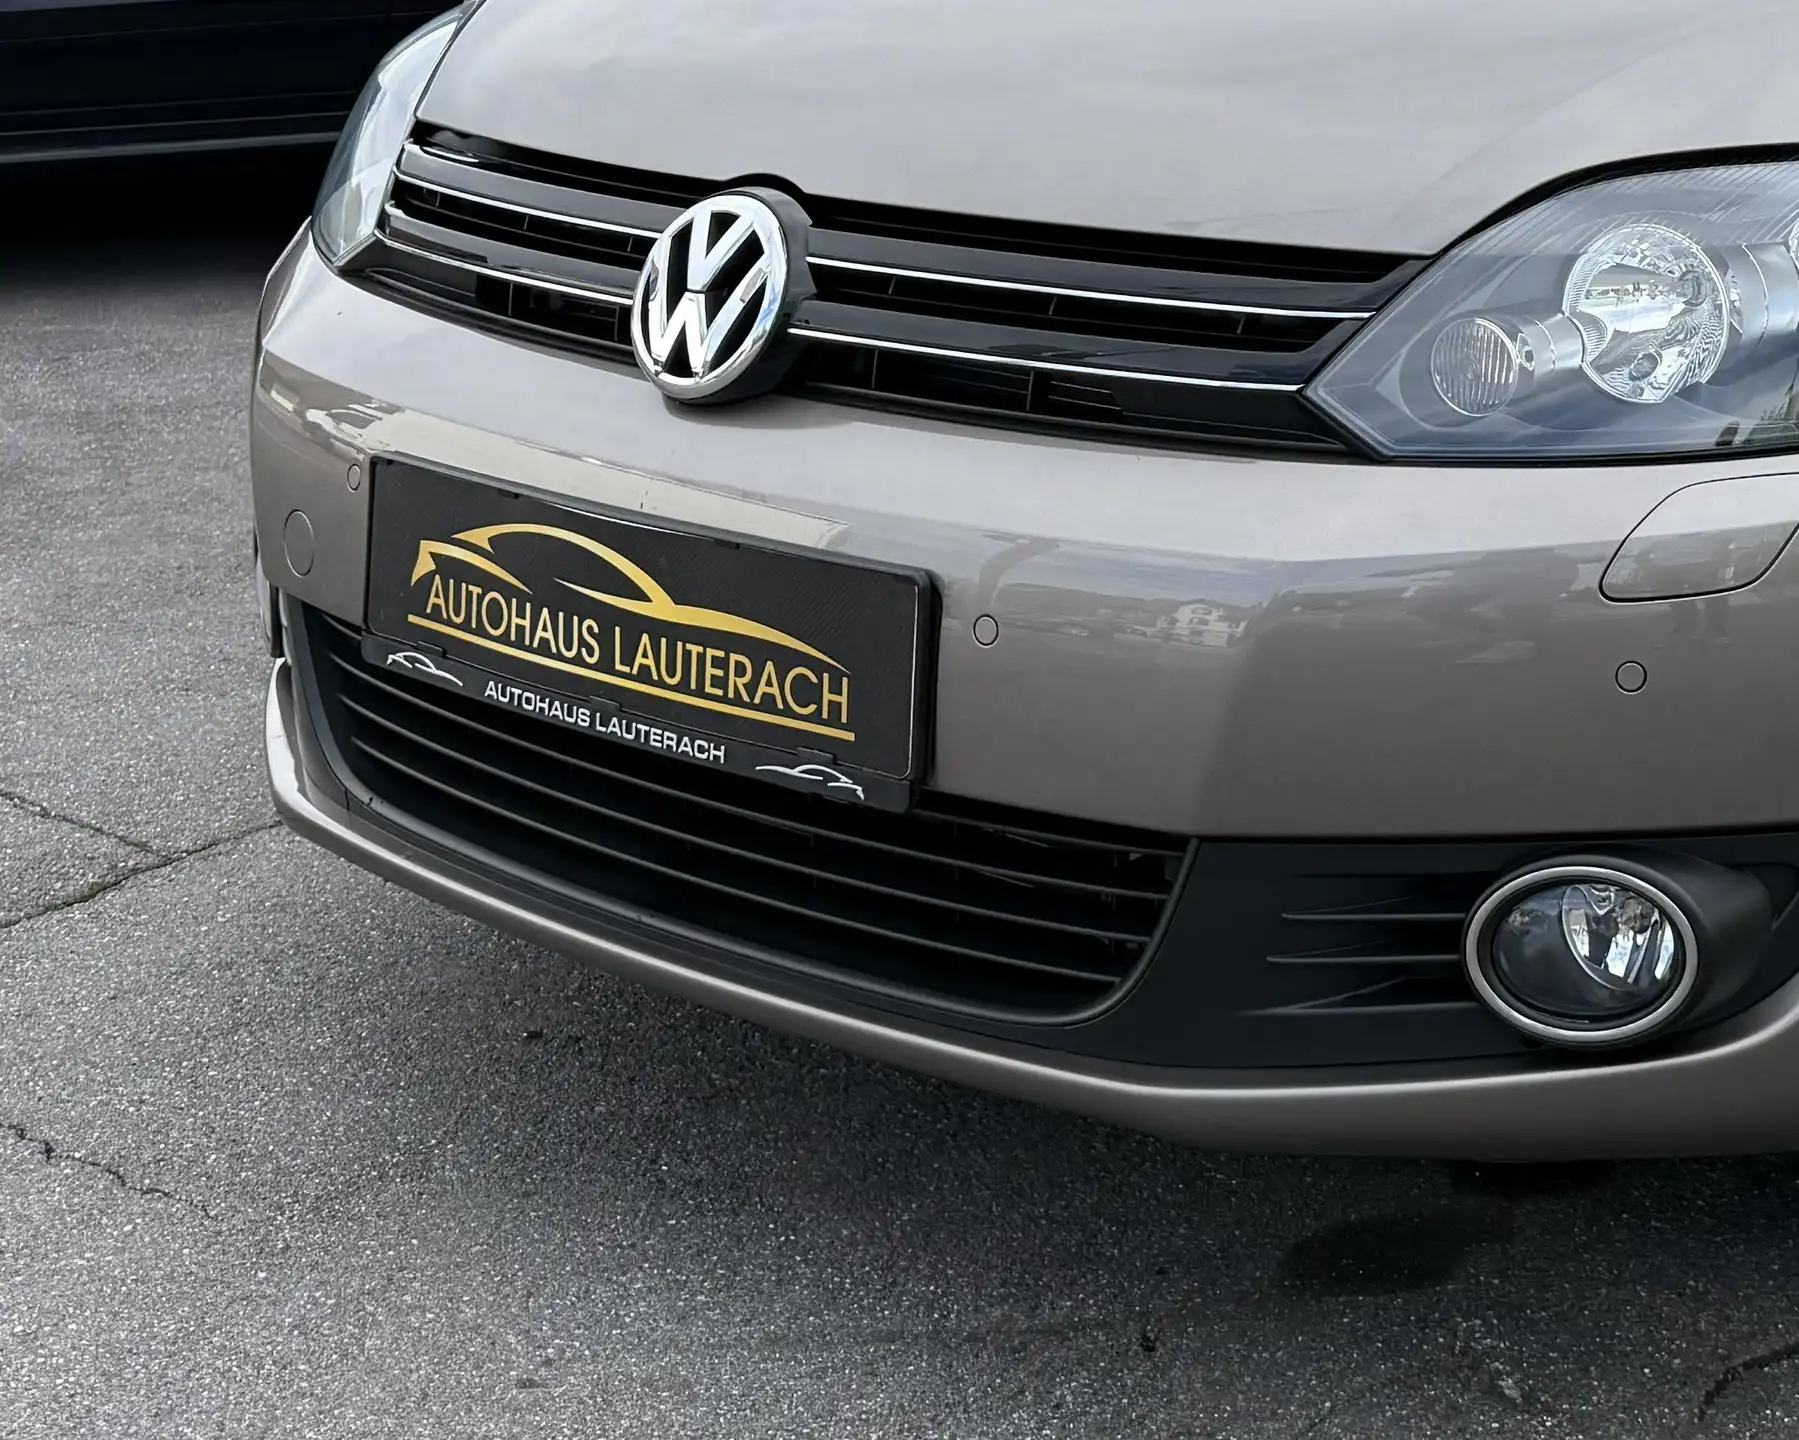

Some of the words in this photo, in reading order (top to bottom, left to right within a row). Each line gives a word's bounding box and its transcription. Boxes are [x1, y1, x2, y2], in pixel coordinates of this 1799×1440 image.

[425, 572, 600, 665] AUTOHAUS
[613, 625, 850, 724] LAUTERACH
[483, 678, 591, 728] AUTOHAUS
[595, 710, 727, 765] LAUTERACH
